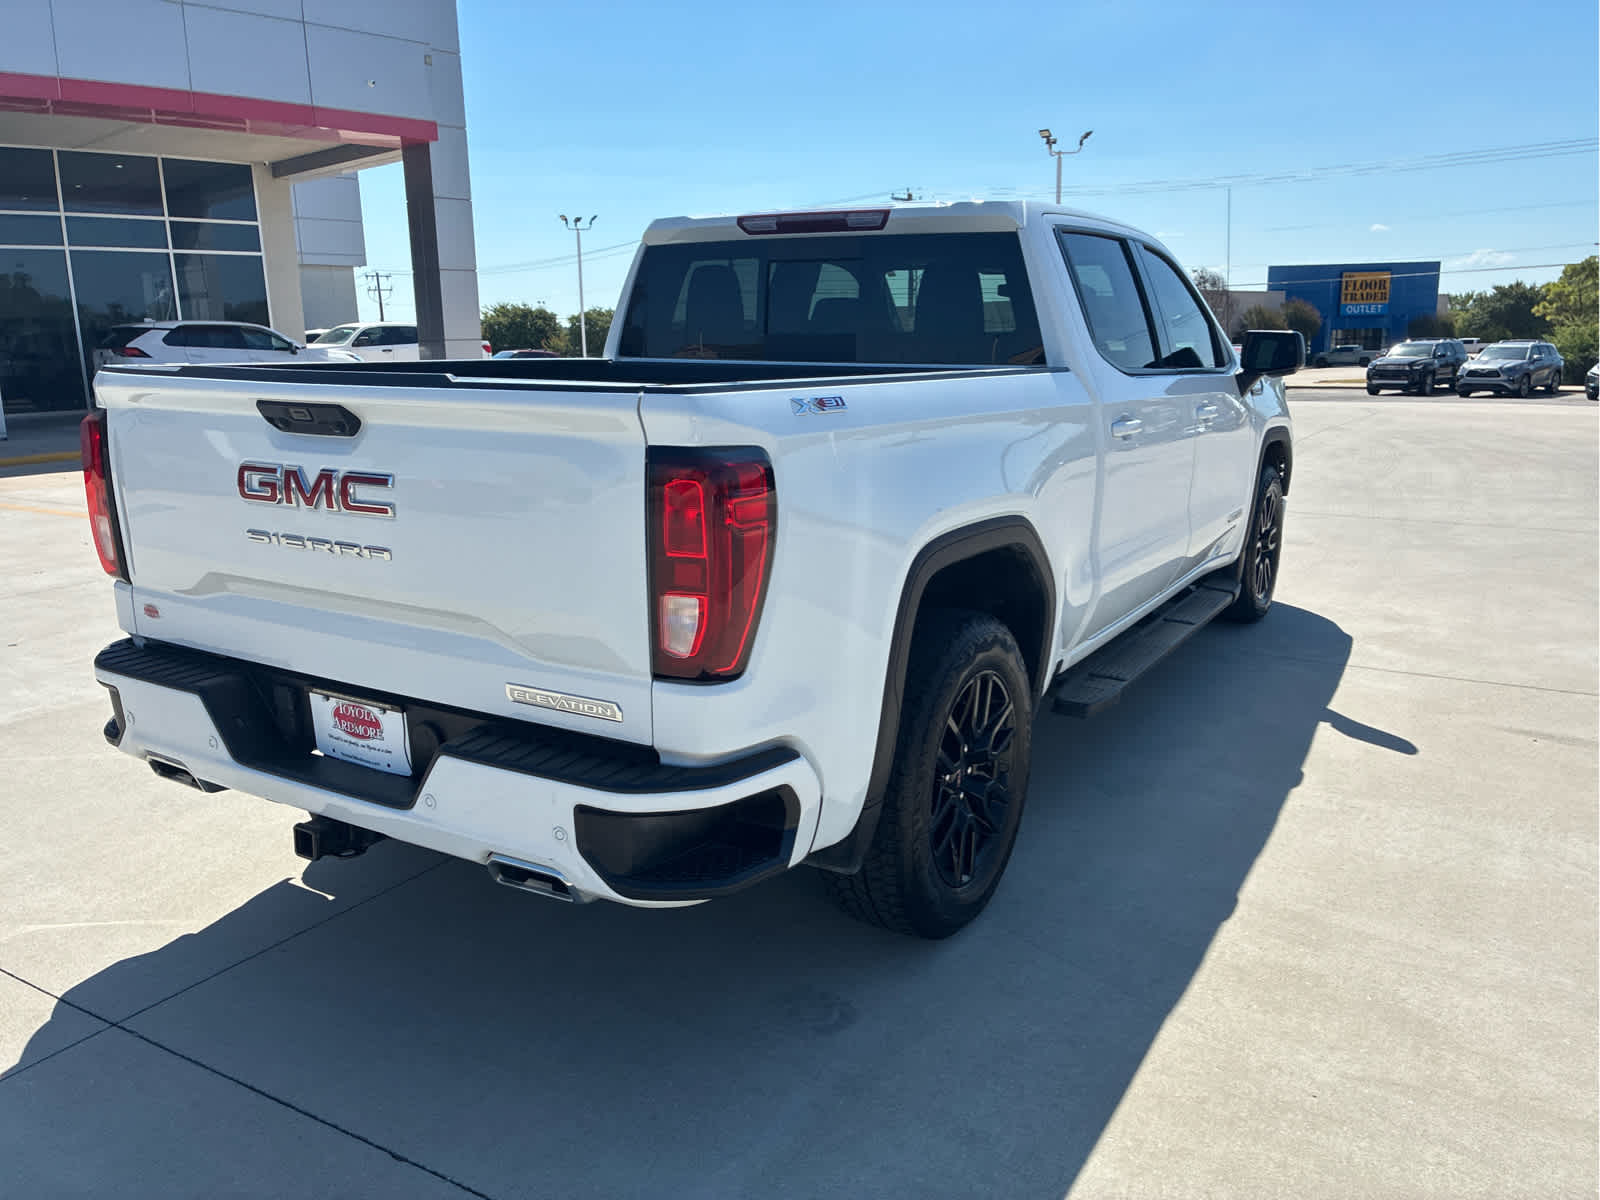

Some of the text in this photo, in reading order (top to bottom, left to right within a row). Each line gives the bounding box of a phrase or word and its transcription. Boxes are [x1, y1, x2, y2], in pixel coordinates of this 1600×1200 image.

[1344, 279, 1387, 291] FLOOR
[1343, 292, 1387, 302] TRADER
[1345, 304, 1383, 313] OUTLET
[237, 461, 396, 519] GMC
[246, 527, 393, 561] SIERRA
[337, 702, 377, 722] TOYOTA
[513, 690, 612, 716] ELEVATION
[333, 718, 385, 741] ARDMORE
